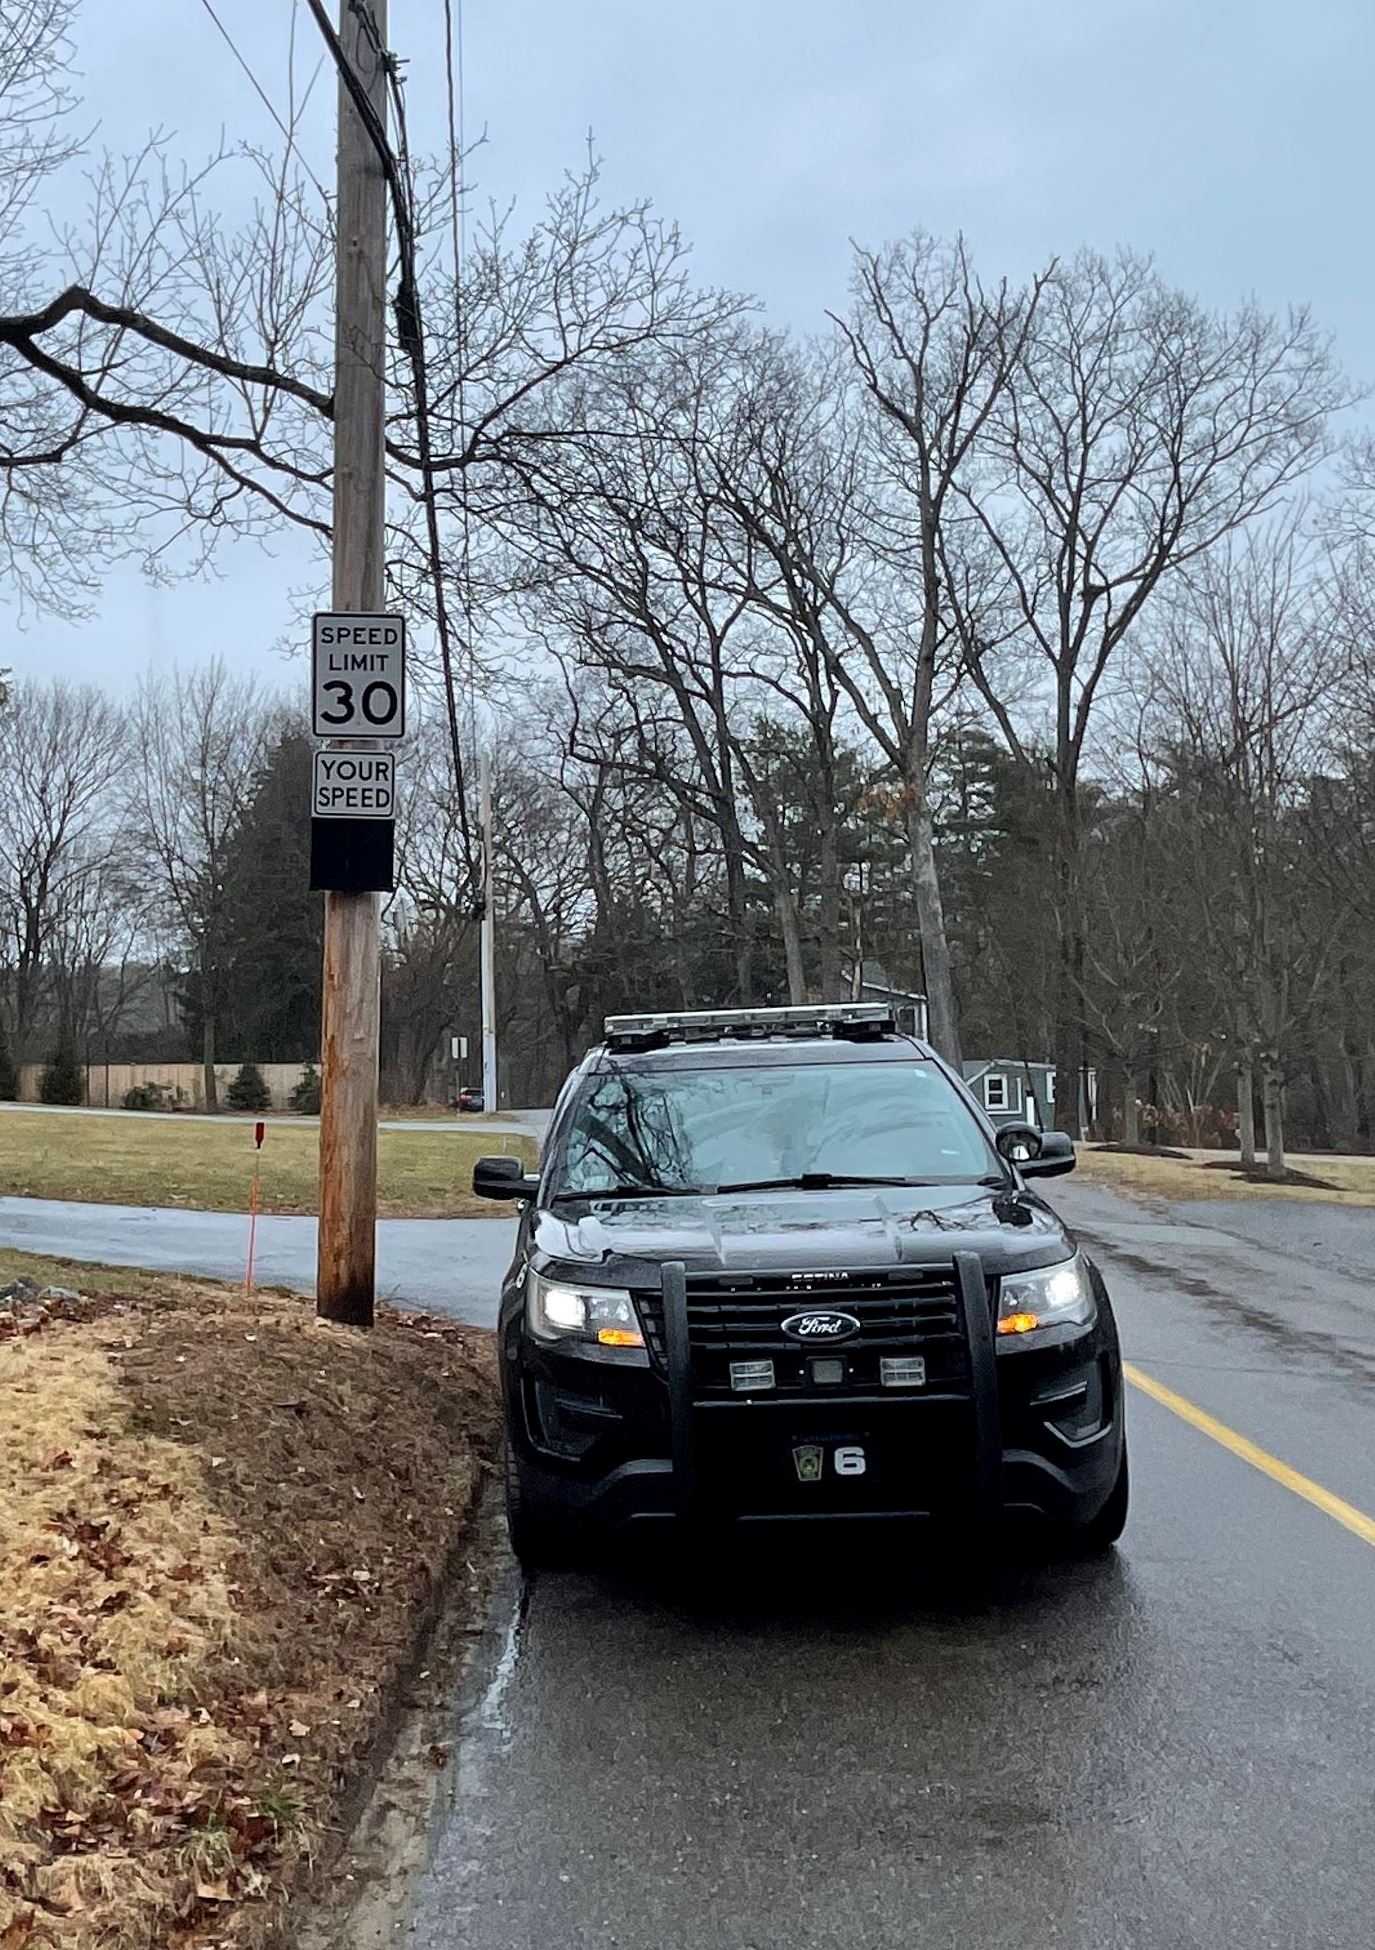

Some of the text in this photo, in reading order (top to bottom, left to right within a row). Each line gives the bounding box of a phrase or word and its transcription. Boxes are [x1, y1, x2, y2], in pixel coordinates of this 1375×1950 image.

[321, 627, 398, 645] SPEED
[329, 654, 389, 671] LIMIT
[320, 680, 398, 725] 30
[321, 760, 389, 781] YOUR
[318, 787, 390, 808] SPEED
[798, 1316, 842, 1335] Ford
[834, 1447, 866, 1475] 6
